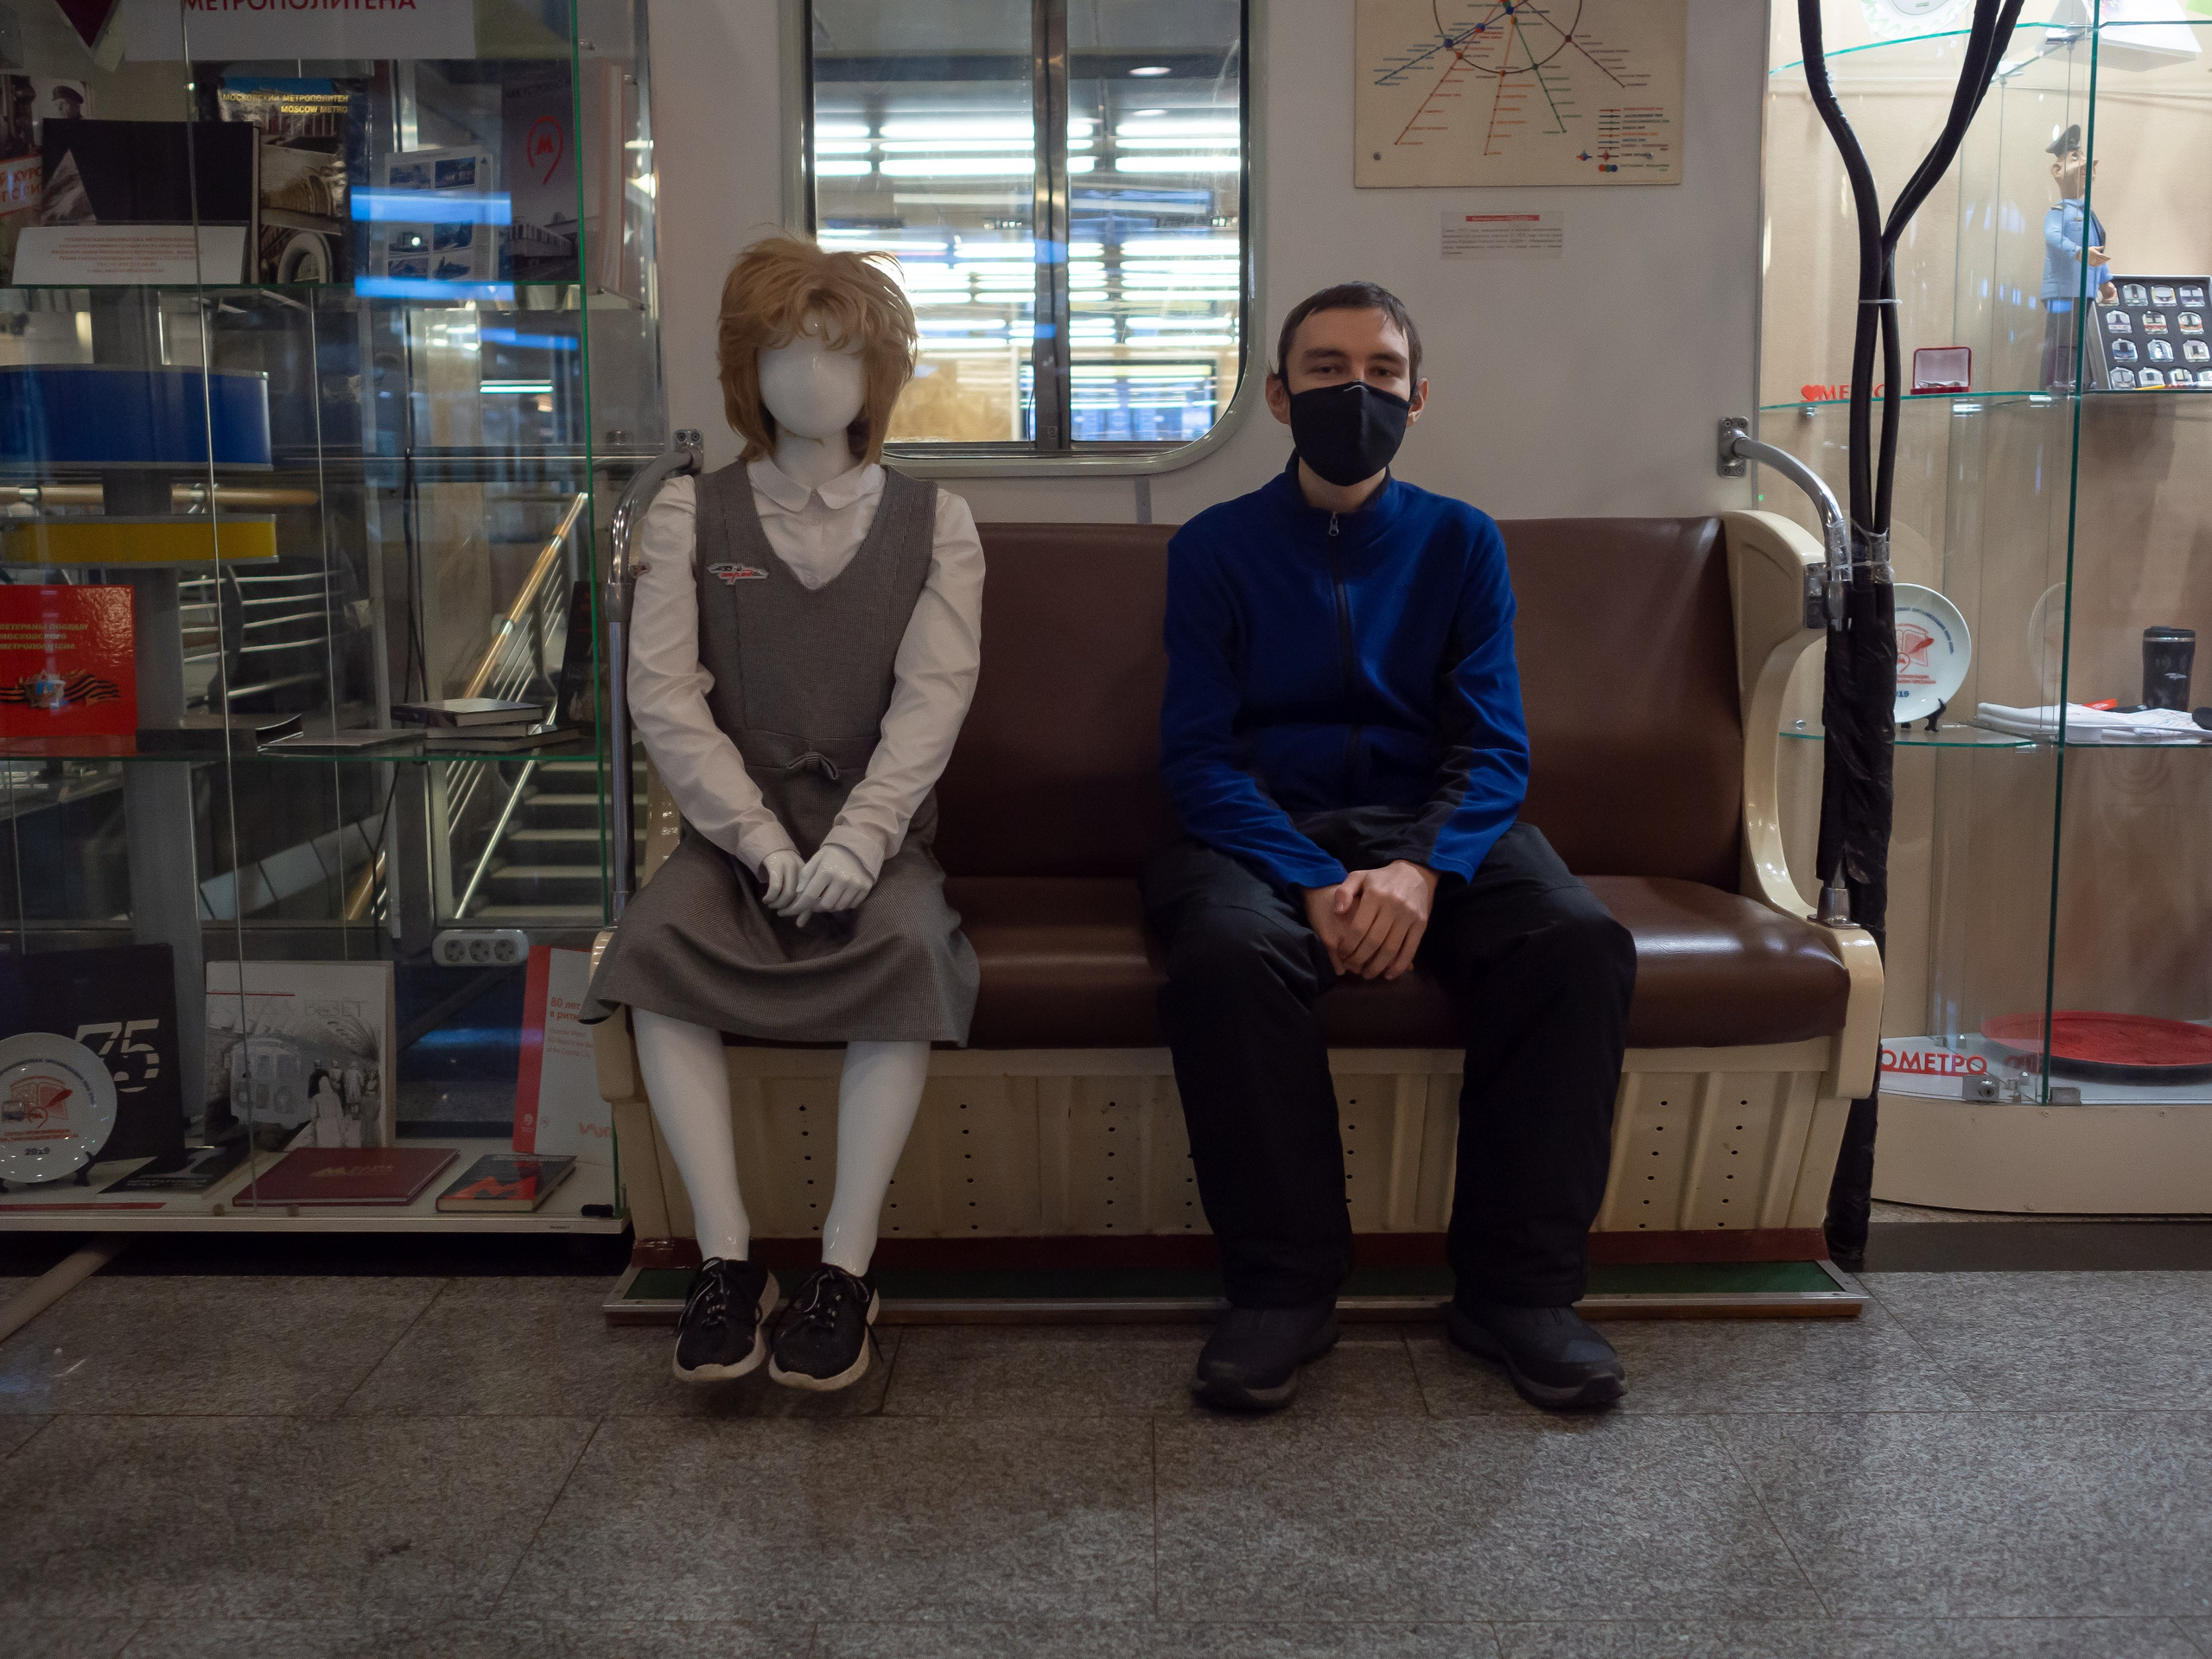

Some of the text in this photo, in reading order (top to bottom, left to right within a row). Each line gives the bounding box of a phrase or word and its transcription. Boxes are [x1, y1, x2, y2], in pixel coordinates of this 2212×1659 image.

[283, 94, 349, 103] МЕТРОПОЛИТЕН
[281, 105, 348, 113] MOSCOW METRO
[550, 997, 581, 1010] 80 лет
[556, 1011, 580, 1021] ритм
[75, 1018, 160, 1093] 75
[24, 1147, 50, 1156] 2019
